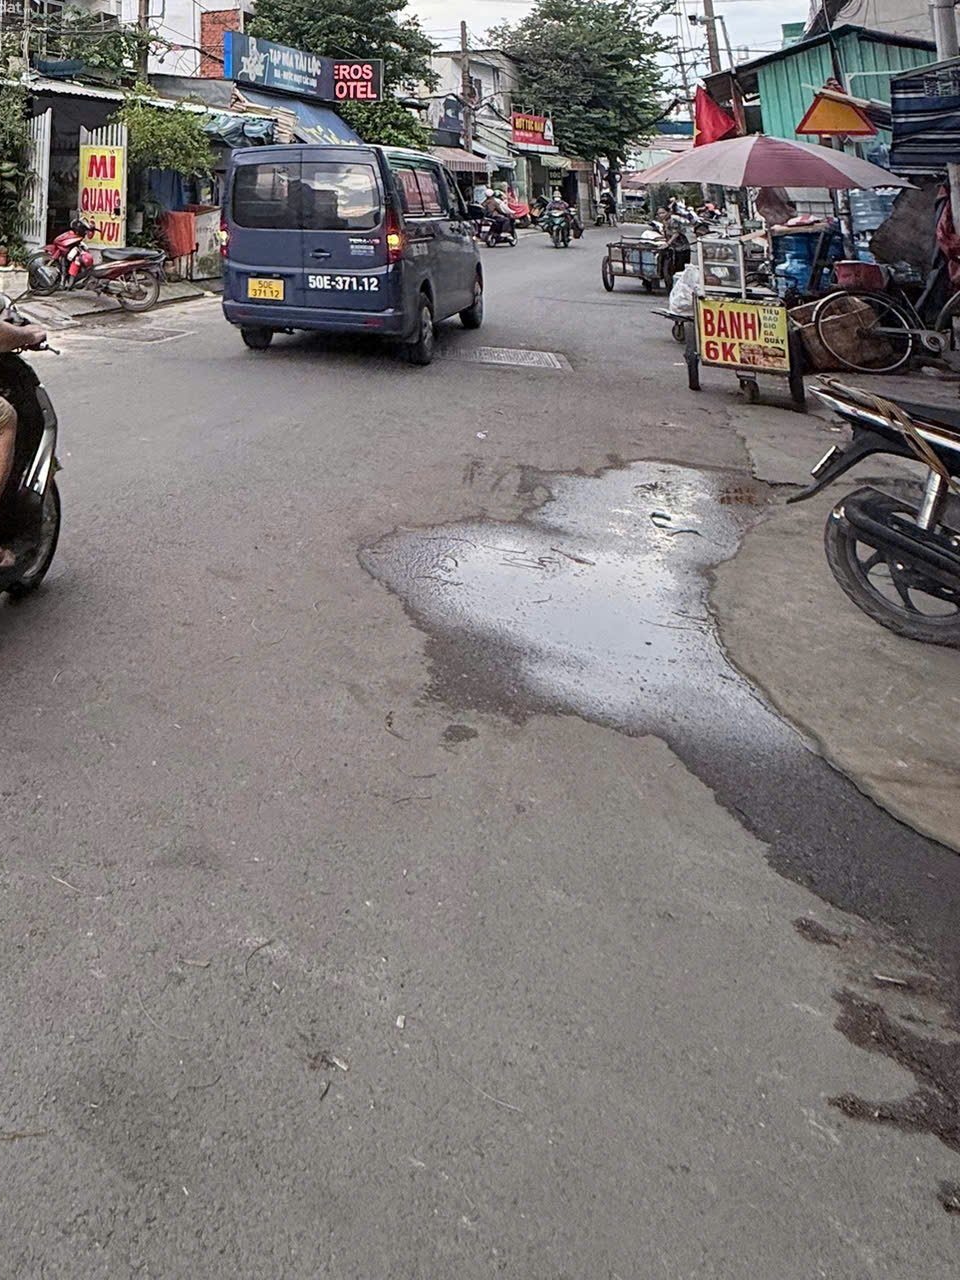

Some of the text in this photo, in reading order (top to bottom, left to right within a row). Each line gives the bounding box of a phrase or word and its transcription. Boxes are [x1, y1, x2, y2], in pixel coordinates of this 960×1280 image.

[335, 82, 377, 99] OTEL
[100, 221, 119, 241] VUI
[258, 281, 273, 289] 50E
[308, 275, 379, 291] 50E-371.12
[703, 303, 757, 341] BÁNH
[705, 340, 737, 362] 6K
